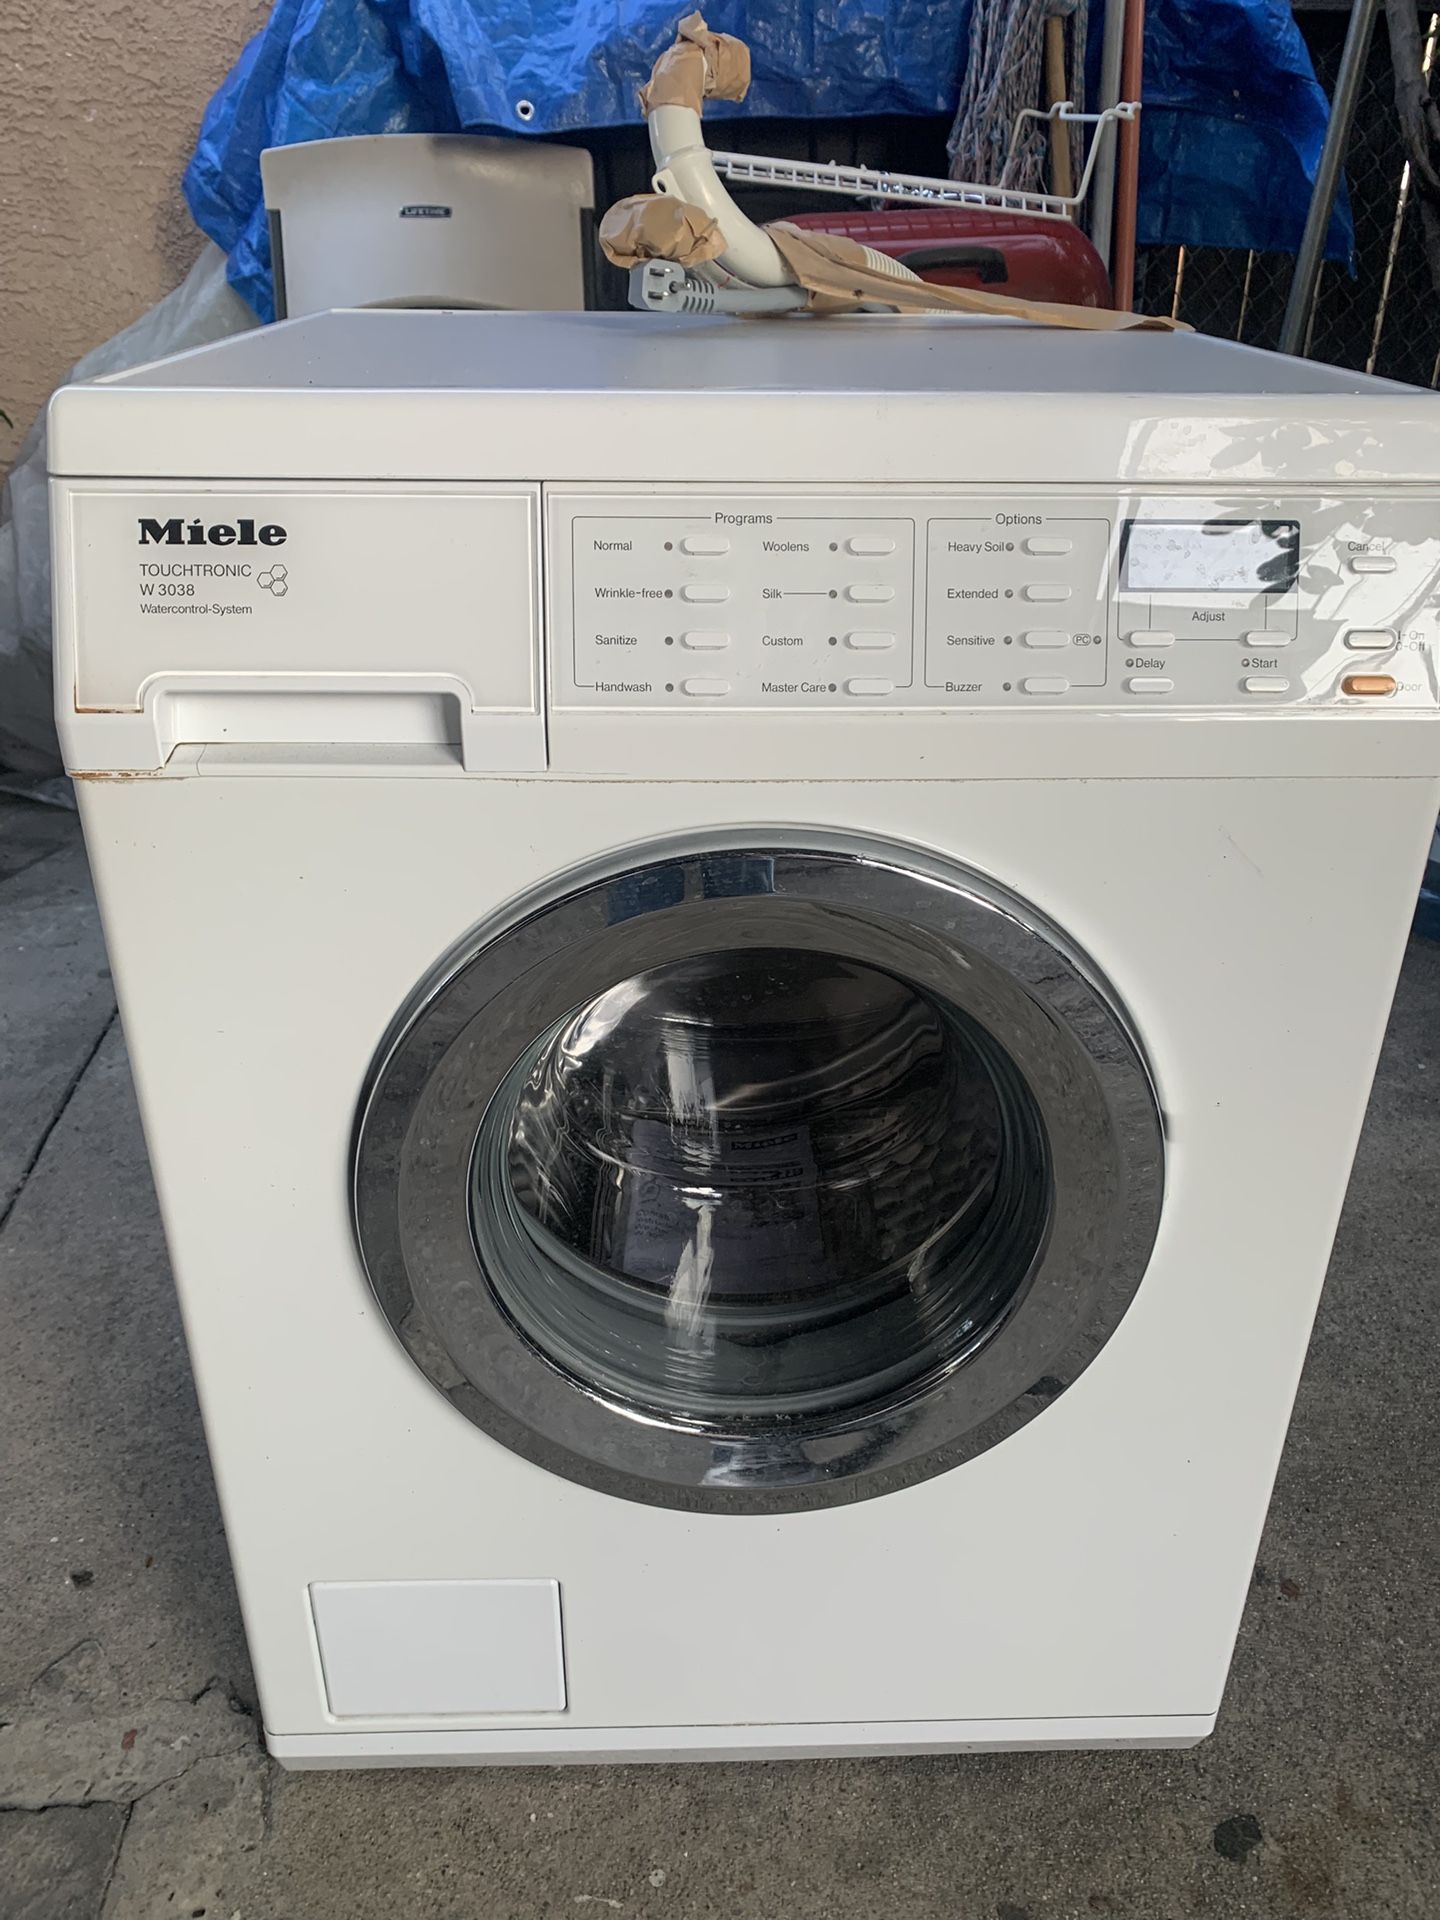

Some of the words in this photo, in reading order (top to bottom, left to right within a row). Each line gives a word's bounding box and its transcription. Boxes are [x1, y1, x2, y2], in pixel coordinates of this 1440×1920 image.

[714, 512, 773, 526] Programs
[995, 513, 1043, 527] Options
[137, 518, 288, 546] Miele
[593, 540, 633, 551] Normal
[762, 541, 810, 552] Woolens
[947, 541, 982, 554] Heavy
[984, 541, 1005, 552] Soil
[1347, 541, 1385, 552] Cancel
[139, 563, 252, 577] TOUCHTRONIC
[139, 583, 155, 596] W
[158, 583, 195, 597] 3038
[594, 587, 663, 599] Wrinkle-free
[762, 588, 783, 599] Silk
[947, 588, 999, 599] Extended
[140, 603, 253, 617] Watercontrol-System
[1191, 611, 1226, 623] Adjust
[595, 634, 638, 646] Sanitize
[762, 635, 804, 646] Custom
[946, 635, 996, 646] Sensitive
[1075, 636, 1090, 645] PC
[1135, 657, 1166, 670] Delay
[1251, 657, 1279, 669] Start
[595, 681, 652, 692] Handwash
[761, 682, 798, 693] Master
[800, 682, 827, 693] Care
[945, 681, 983, 693] Buzzer
